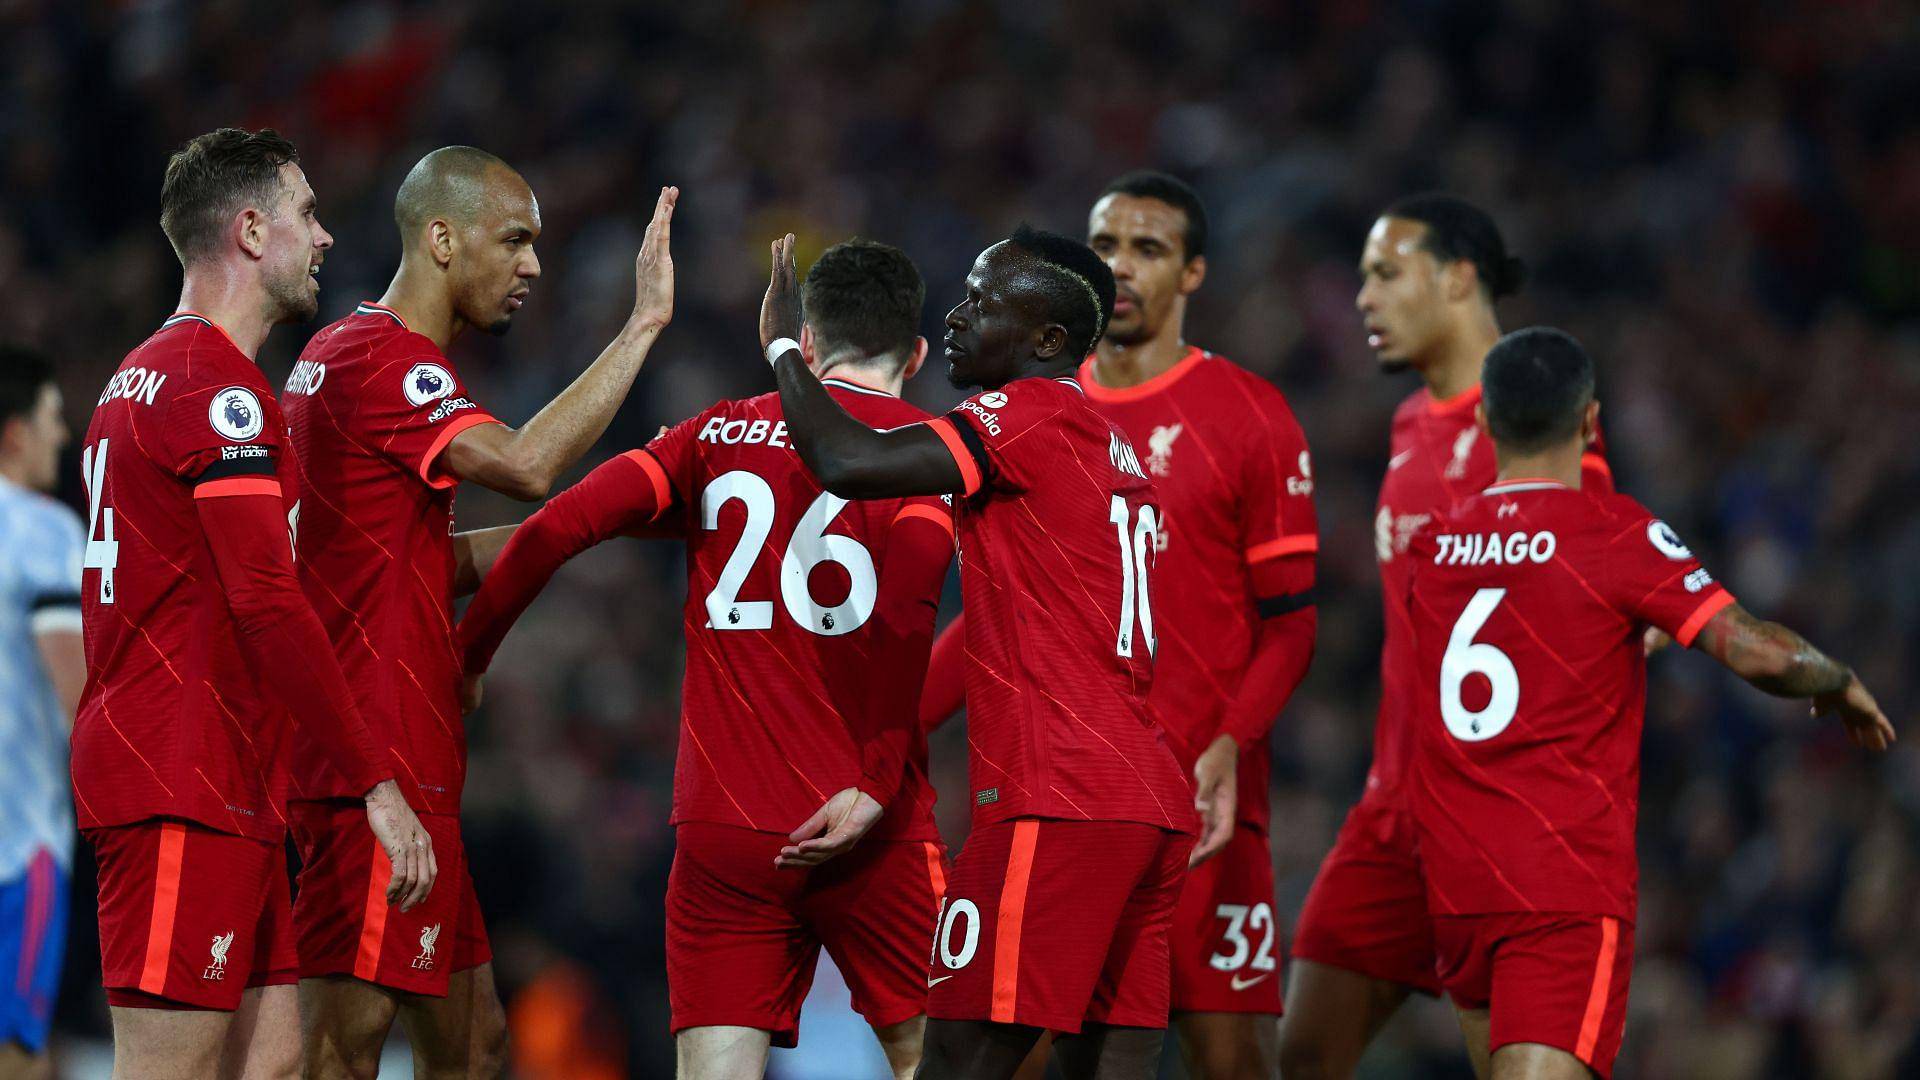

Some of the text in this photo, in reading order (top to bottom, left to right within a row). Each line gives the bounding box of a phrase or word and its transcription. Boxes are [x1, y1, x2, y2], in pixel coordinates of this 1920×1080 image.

[698, 416, 796, 450] ROBE
[701, 470, 878, 636] 26
[1110, 495, 1157, 660] 10
[1433, 530, 1557, 566] THIAGO
[1440, 588, 1520, 742] 6
[1210, 902, 1276, 971] 32
